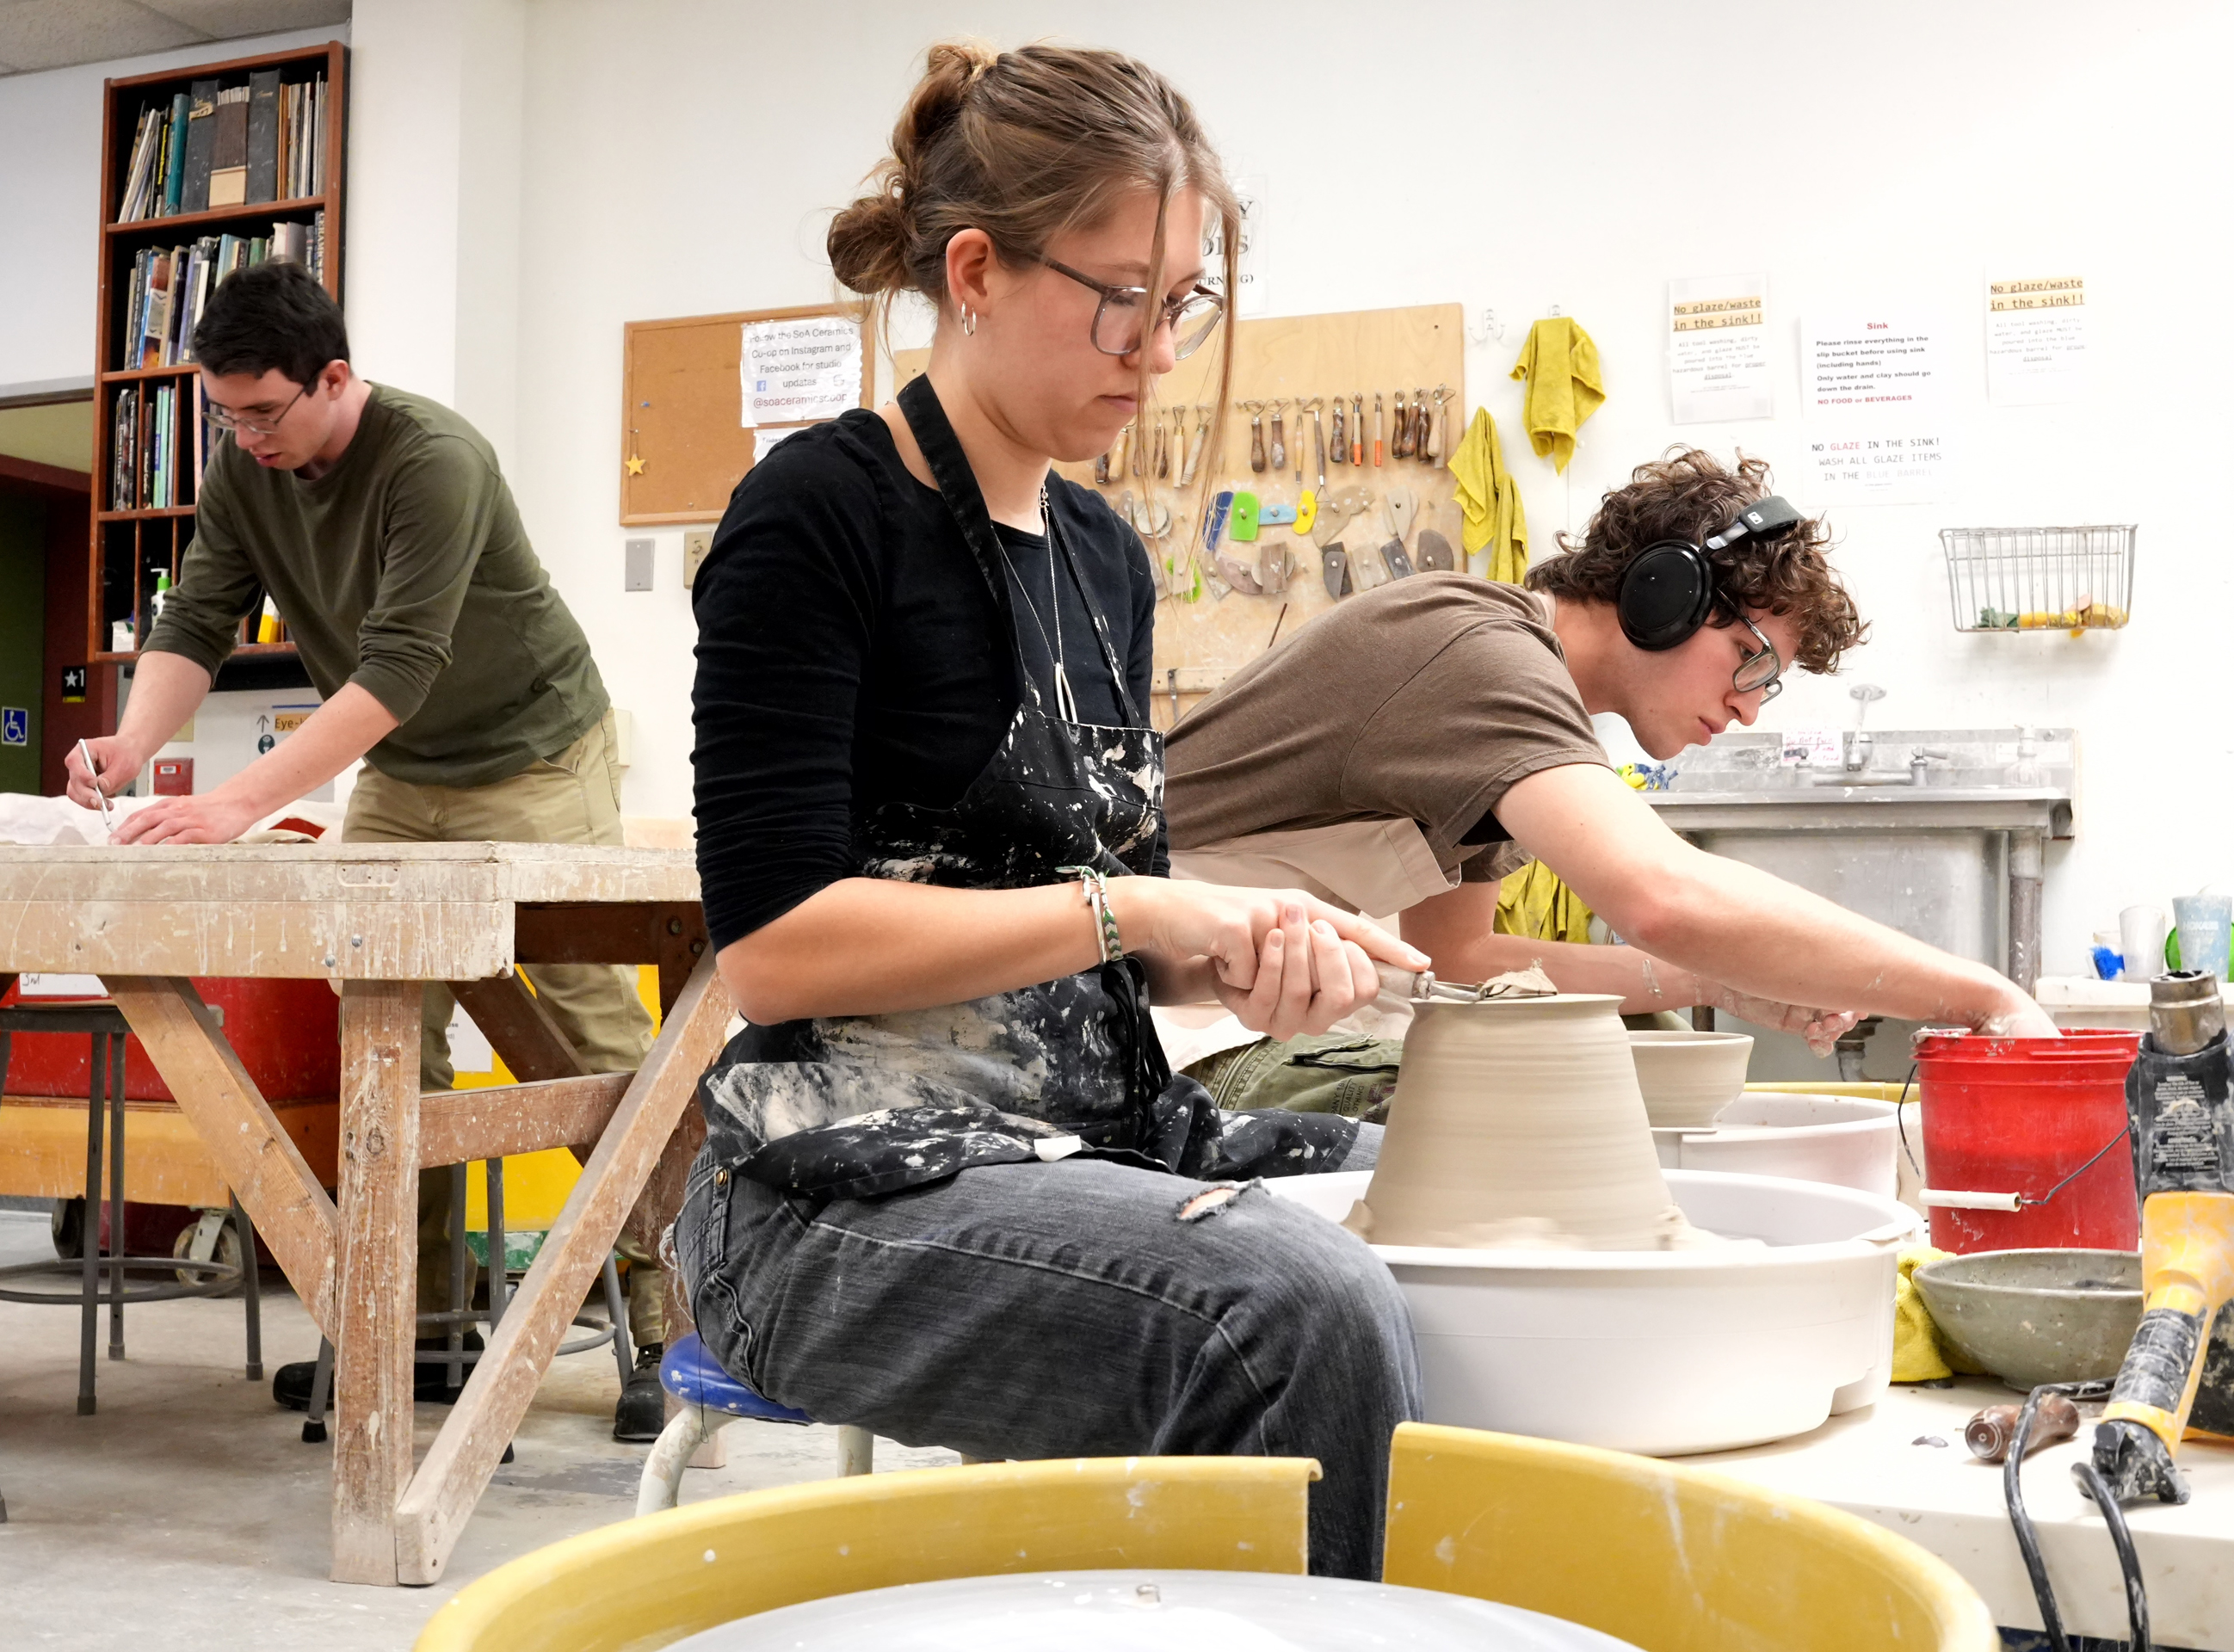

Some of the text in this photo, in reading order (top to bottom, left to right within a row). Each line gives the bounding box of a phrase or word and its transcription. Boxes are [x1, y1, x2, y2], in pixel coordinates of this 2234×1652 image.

[1199, 274, 1254, 287] URNG)
[1990, 279, 2083, 294] No glaze/waste
[1674, 299, 1762, 315] No glaze/waste
[1990, 293, 2083, 310] in the sink!!
[1674, 313, 1762, 330] in the sink!!
[1867, 322, 1888, 330] Sink
[778, 331, 791, 340] the
[793, 330, 811, 339] SoA
[812, 327, 854, 336] Ceramics
[791, 346, 833, 356] Instagram
[835, 342, 851, 352] and
[760, 359, 842, 373] Facebook for studio
[1817, 361, 1854, 369] (including
[782, 379, 818, 389] updates
[1811, 437, 1940, 452] NO GLAZE IN THE SINK!
[1818, 453, 1942, 466] WASH ALL GLAZE ITEMS
[1824, 468, 1933, 481] IN THE BLUE BARREL
[1330, 1093, 1340, 1114] PANY
[1342, 1081, 1356, 1112] QUALITY
